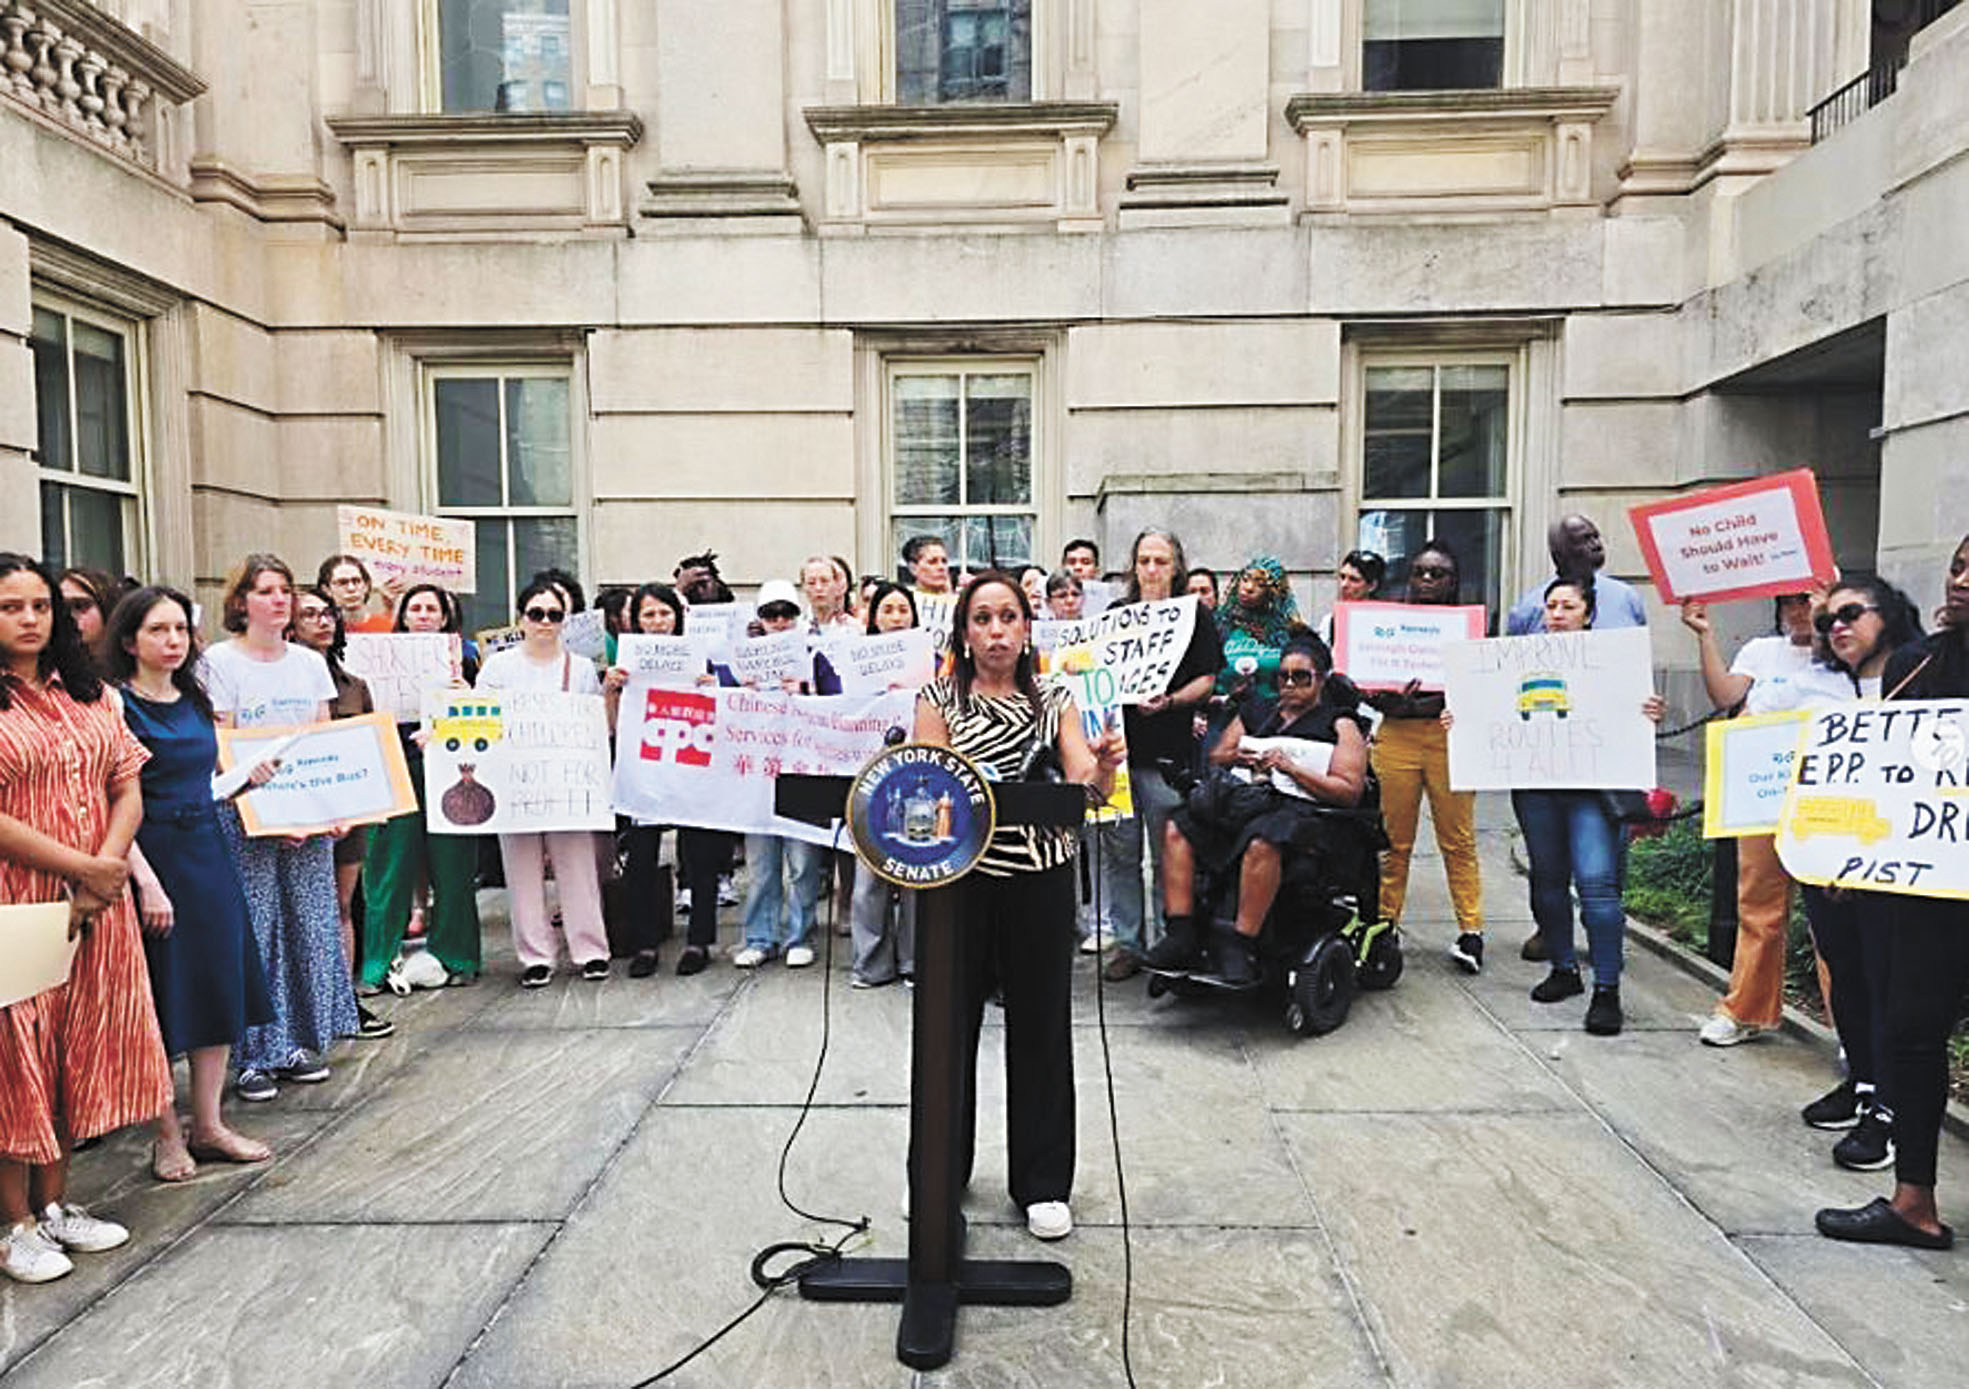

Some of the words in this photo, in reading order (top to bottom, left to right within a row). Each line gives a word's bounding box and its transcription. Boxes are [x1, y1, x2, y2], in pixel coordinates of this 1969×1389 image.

[356, 514, 386, 530] ON
[1689, 525, 1711, 537] No
[1714, 514, 1758, 533] Child
[350, 532, 410, 559] EVERY
[420, 546, 464, 569] TIME
[1680, 539, 1735, 560] Should
[1737, 531, 1779, 549] Have
[1702, 562, 1720, 575] to
[1722, 553, 1765, 571] Wait!
[1157, 606, 1182, 625] TO
[356, 637, 450, 674] SHORTER
[1103, 628, 1176, 667] STAFF
[1470, 633, 1605, 675] IMPROVE
[1082, 668, 1115, 705] TO
[726, 693, 788, 715] Chinese
[725, 725, 788, 746] Services
[1488, 718, 1605, 751] ROUTES
[508, 759, 551, 785] NOT
[563, 759, 601, 786] FOR
[858, 757, 893, 797] NEW
[895, 748, 945, 766] YORK
[944, 755, 986, 806] STATE
[1880, 764, 1915, 784] TO
[882, 857, 955, 881] SENATE
[1836, 856, 1934, 887] PIST
